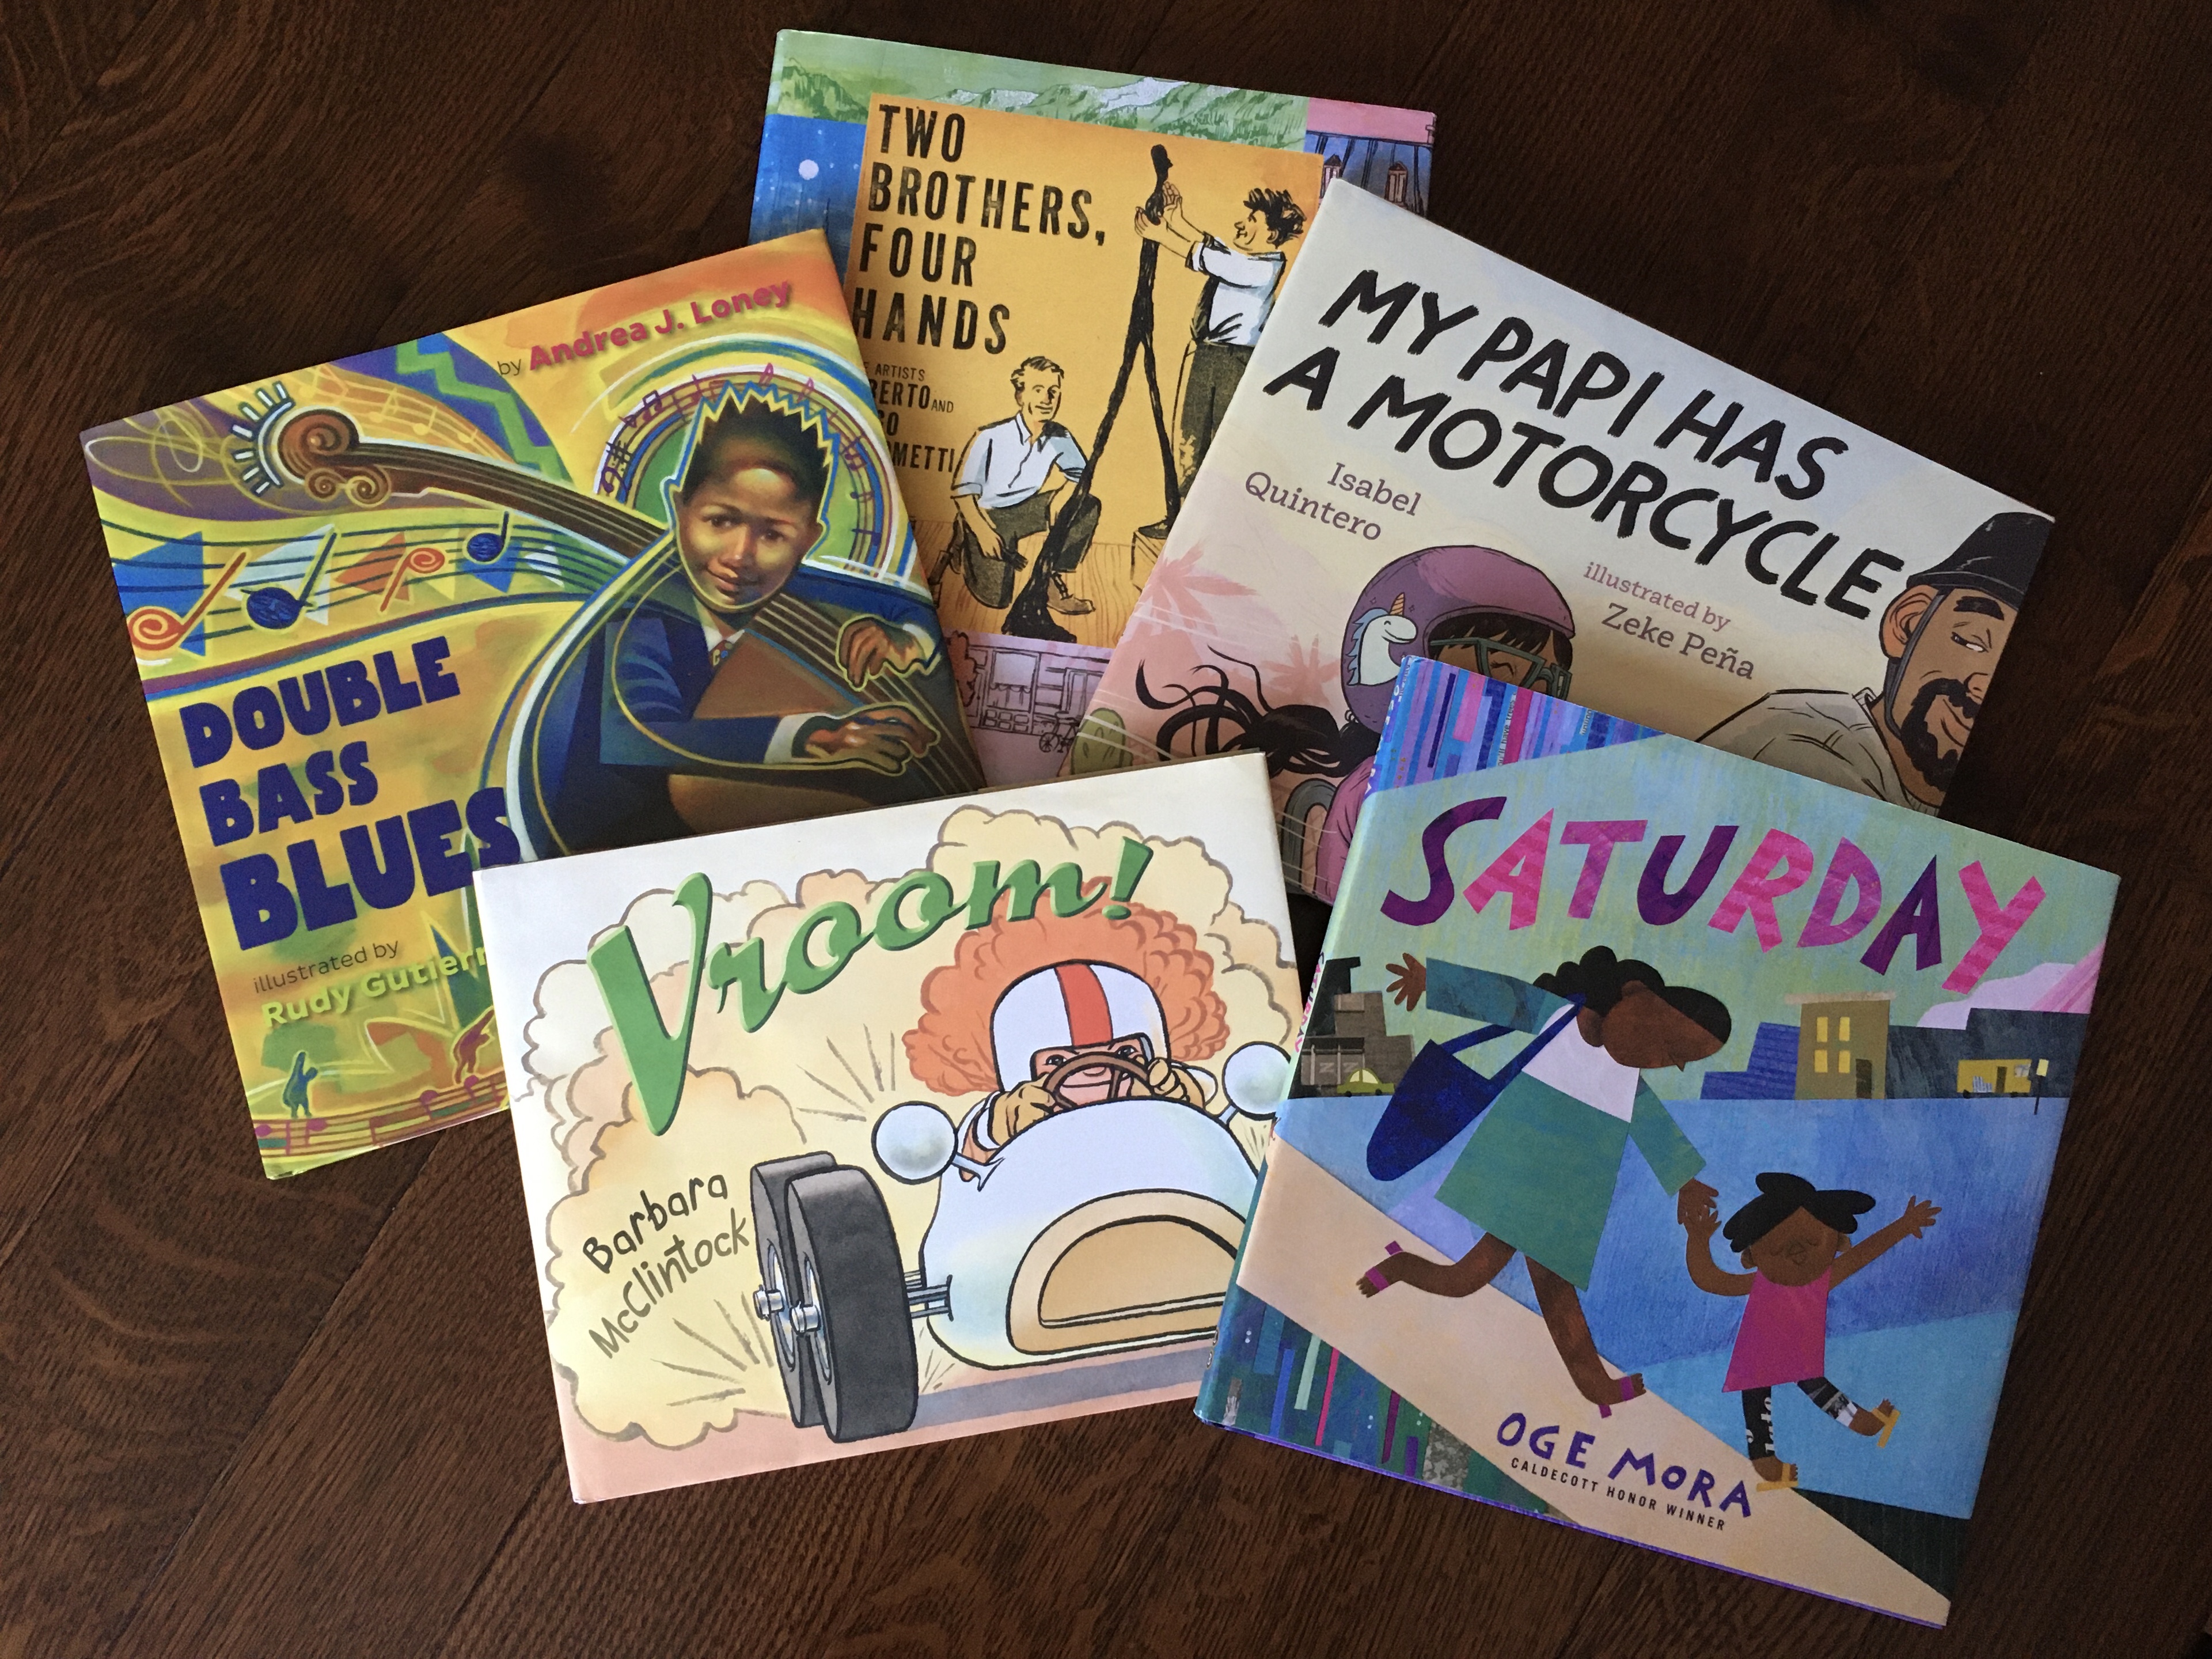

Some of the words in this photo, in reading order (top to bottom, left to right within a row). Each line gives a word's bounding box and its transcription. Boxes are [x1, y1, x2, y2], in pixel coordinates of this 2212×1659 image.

[879, 104, 965, 162] TWO
[868, 162, 1105, 245] BROTHERS,
[859, 223, 976, 286] FOUR
[498, 357, 522, 375] by
[529, 322, 647, 370] Andrea
[655, 309, 684, 334] J.
[690, 281, 791, 324] Loney
[852, 287, 1010, 354] HANDS
[868, 379, 930, 409] BERTO
[931, 399, 954, 412] AND
[875, 363, 925, 381] ARTISTS
[1319, 270, 1479, 355] MY
[1456, 316, 1664, 437] PAPI
[1654, 389, 1848, 501] HAS
[887, 441, 955, 472] METTI
[1264, 347, 1340, 411] A
[1348, 374, 1904, 620] MOTORCYCLE
[1327, 463, 1421, 516] Isabel
[1246, 472, 1381, 540] Quintero
[1583, 562, 1699, 618] illustrated
[1702, 606, 1731, 632] by
[1602, 603, 1674, 647] Zeke
[1679, 632, 1754, 680] Peña
[179, 637, 460, 768] DOUBLE
[199, 741, 378, 846] BASS
[219, 787, 521, 950] BLUES
[1380, 797, 2046, 995] SATURDAY
[253, 949, 367, 994] illustrated
[373, 941, 398, 958] by
[261, 984, 351, 1027] Rudy
[361, 947, 487, 998] Gutierr
[587, 838, 1152, 1135] Vroom!
[583, 1175, 727, 1274] Barbara
[589, 1208, 749, 1358] McClintock
[1497, 1412, 1596, 1468] OGE
[1608, 1448, 1751, 1518] MORA
[1511, 1457, 1598, 1492] CALDECOTT
[1607, 1486, 1656, 1510] HONOR
[1667, 1503, 1725, 1531] WINNER
